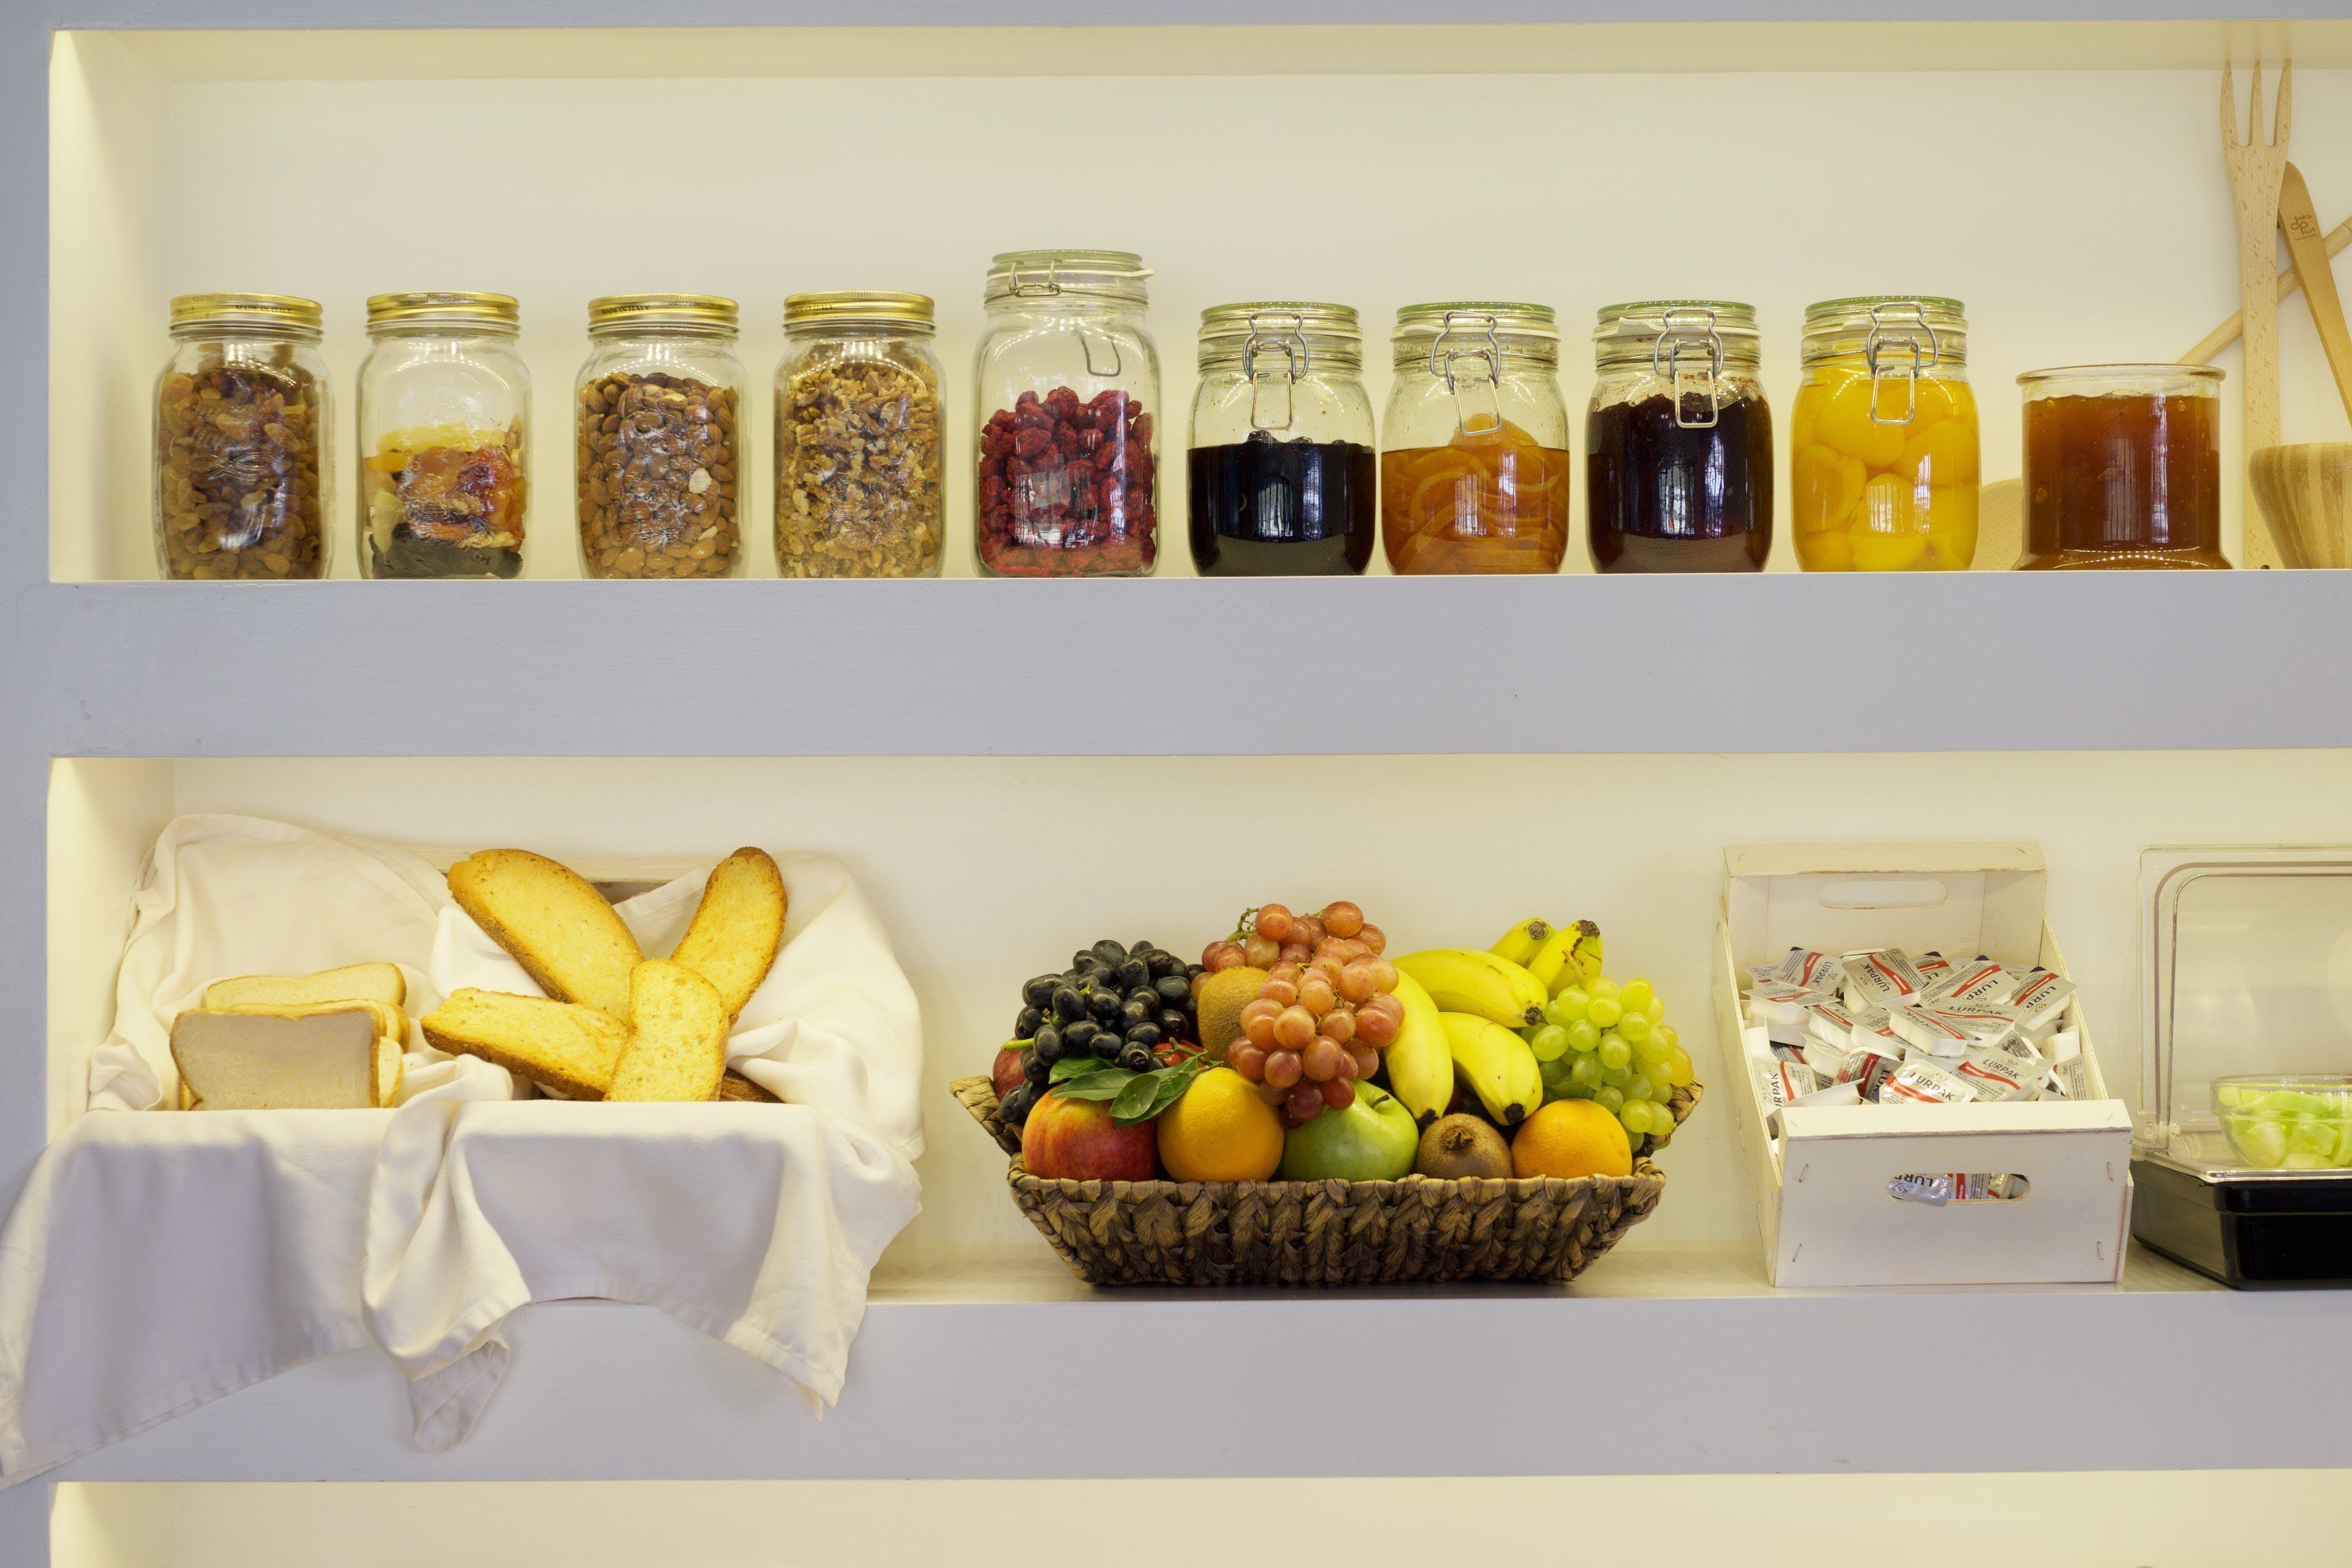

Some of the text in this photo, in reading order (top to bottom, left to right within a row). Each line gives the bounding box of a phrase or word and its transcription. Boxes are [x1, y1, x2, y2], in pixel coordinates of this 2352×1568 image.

[1812, 961, 1834, 985] LURPAK
[1864, 963, 1890, 992] LURPAK
[1949, 1006, 2002, 1015] LURPAK
[1983, 1058, 2020, 1079] LURPAK
[1910, 1072, 1955, 1101] LURPAK
